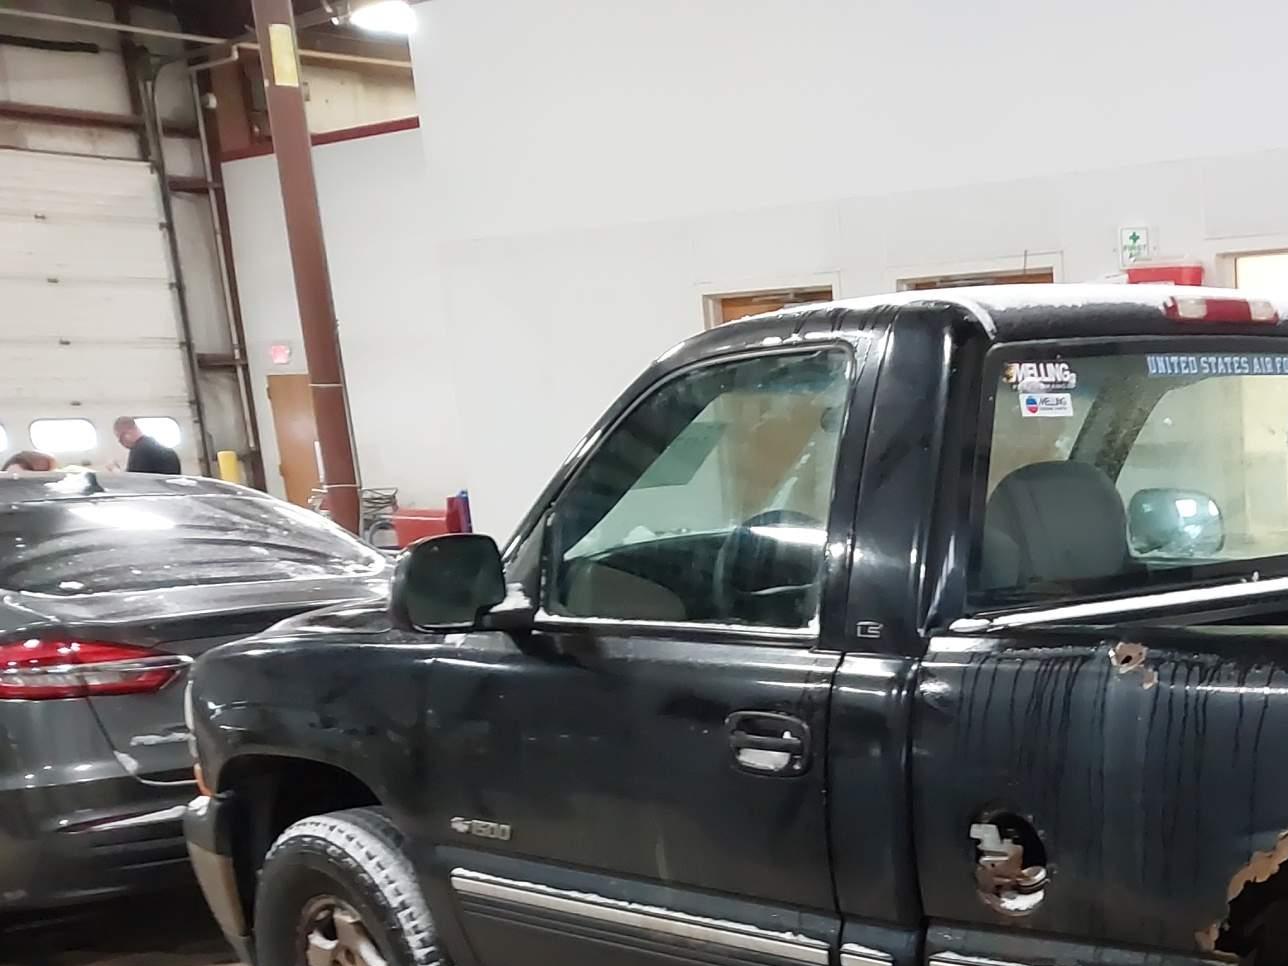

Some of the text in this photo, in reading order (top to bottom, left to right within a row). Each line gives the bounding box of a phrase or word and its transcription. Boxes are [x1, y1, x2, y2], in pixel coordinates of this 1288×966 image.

[1007, 362, 1071, 383] MELLING
[1147, 356, 1198, 374] UNITED
[1200, 356, 1249, 373] STATES
[1252, 356, 1274, 373] AIR
[471, 819, 511, 841] 1500
